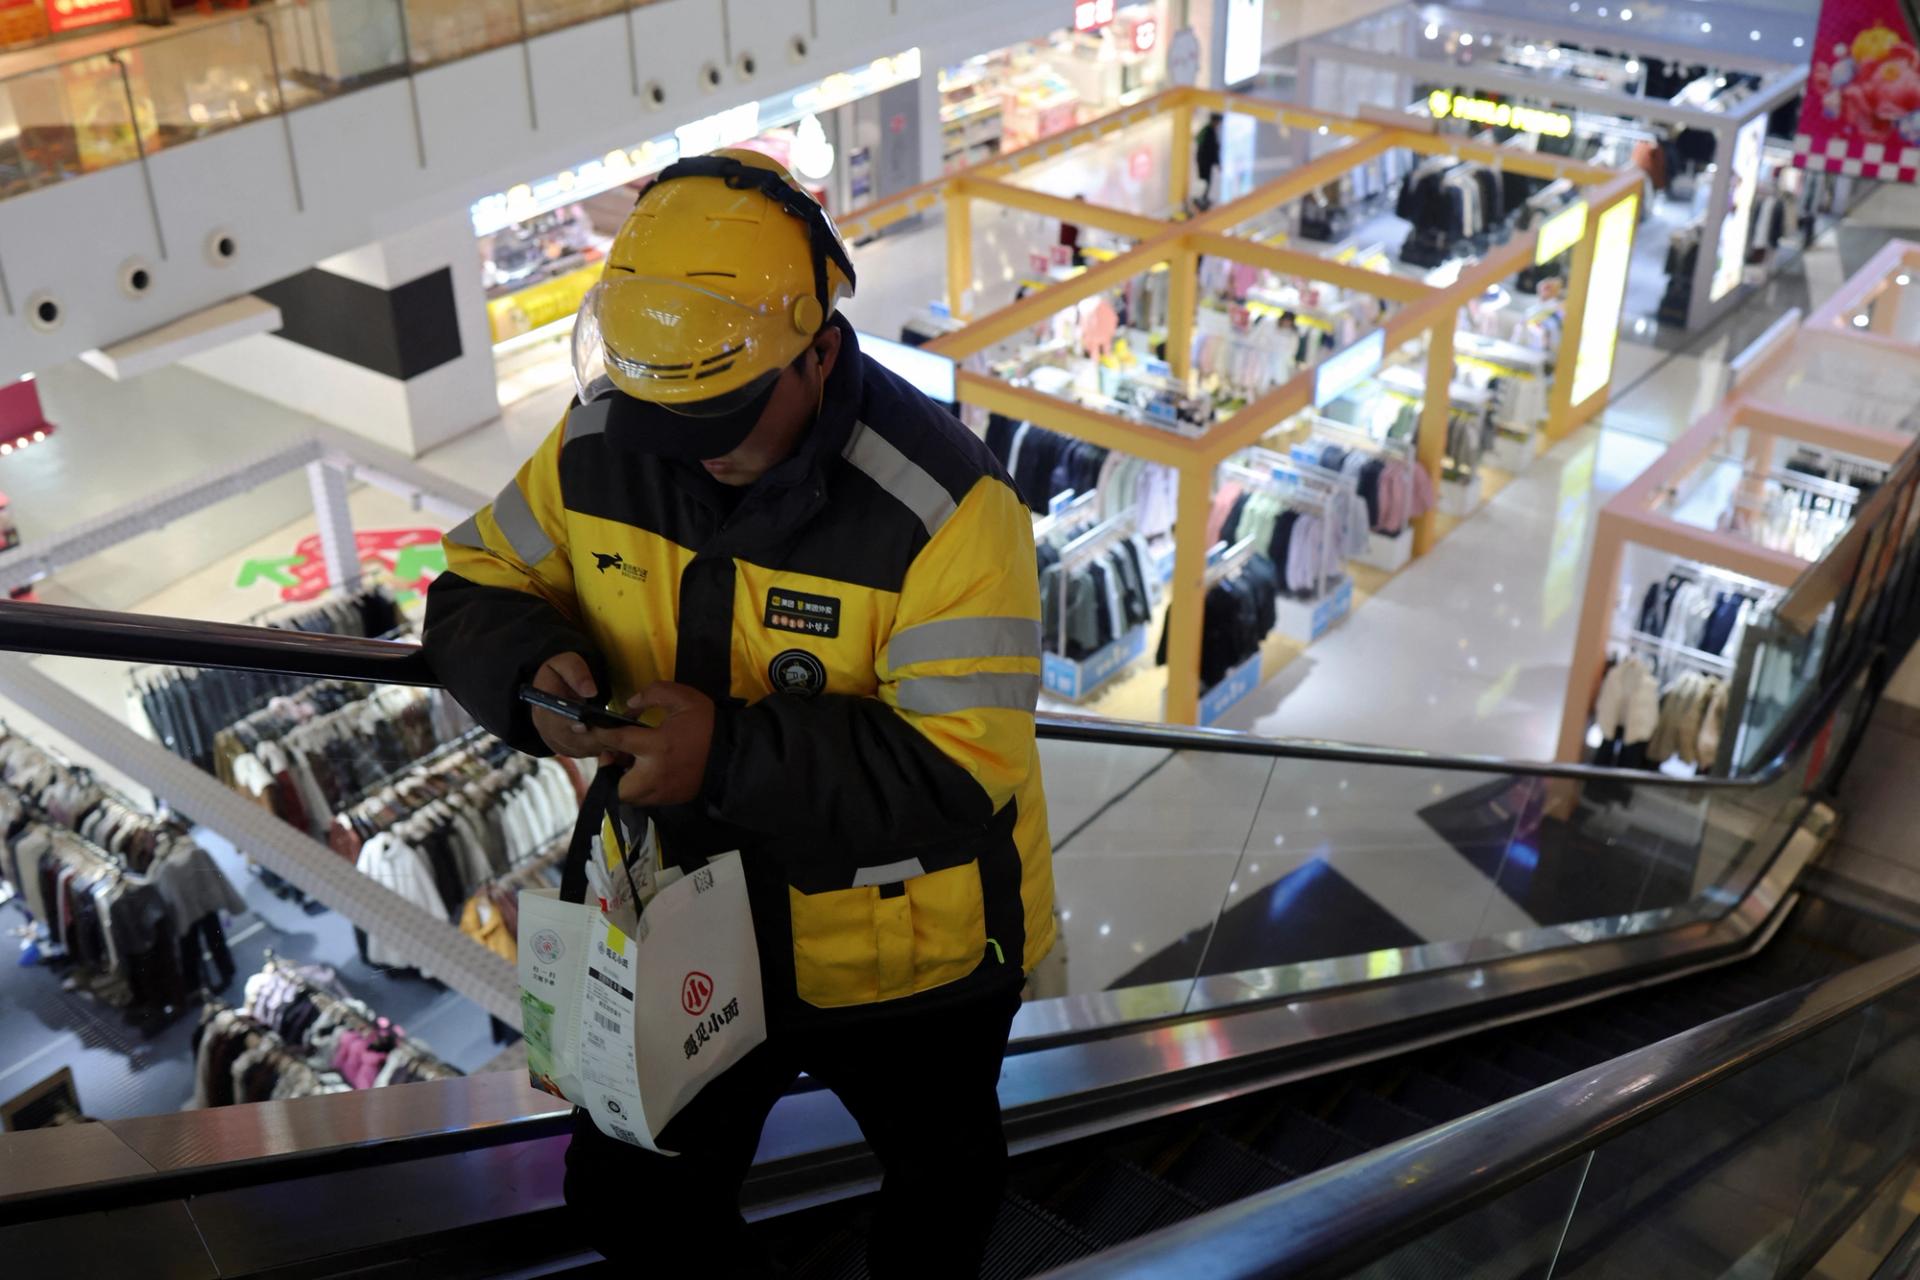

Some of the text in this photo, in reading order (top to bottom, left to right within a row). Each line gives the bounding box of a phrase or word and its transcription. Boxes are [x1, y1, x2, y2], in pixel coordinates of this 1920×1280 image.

[686, 978, 708, 1009] 小
[683, 996, 739, 1060] 遇见小面
